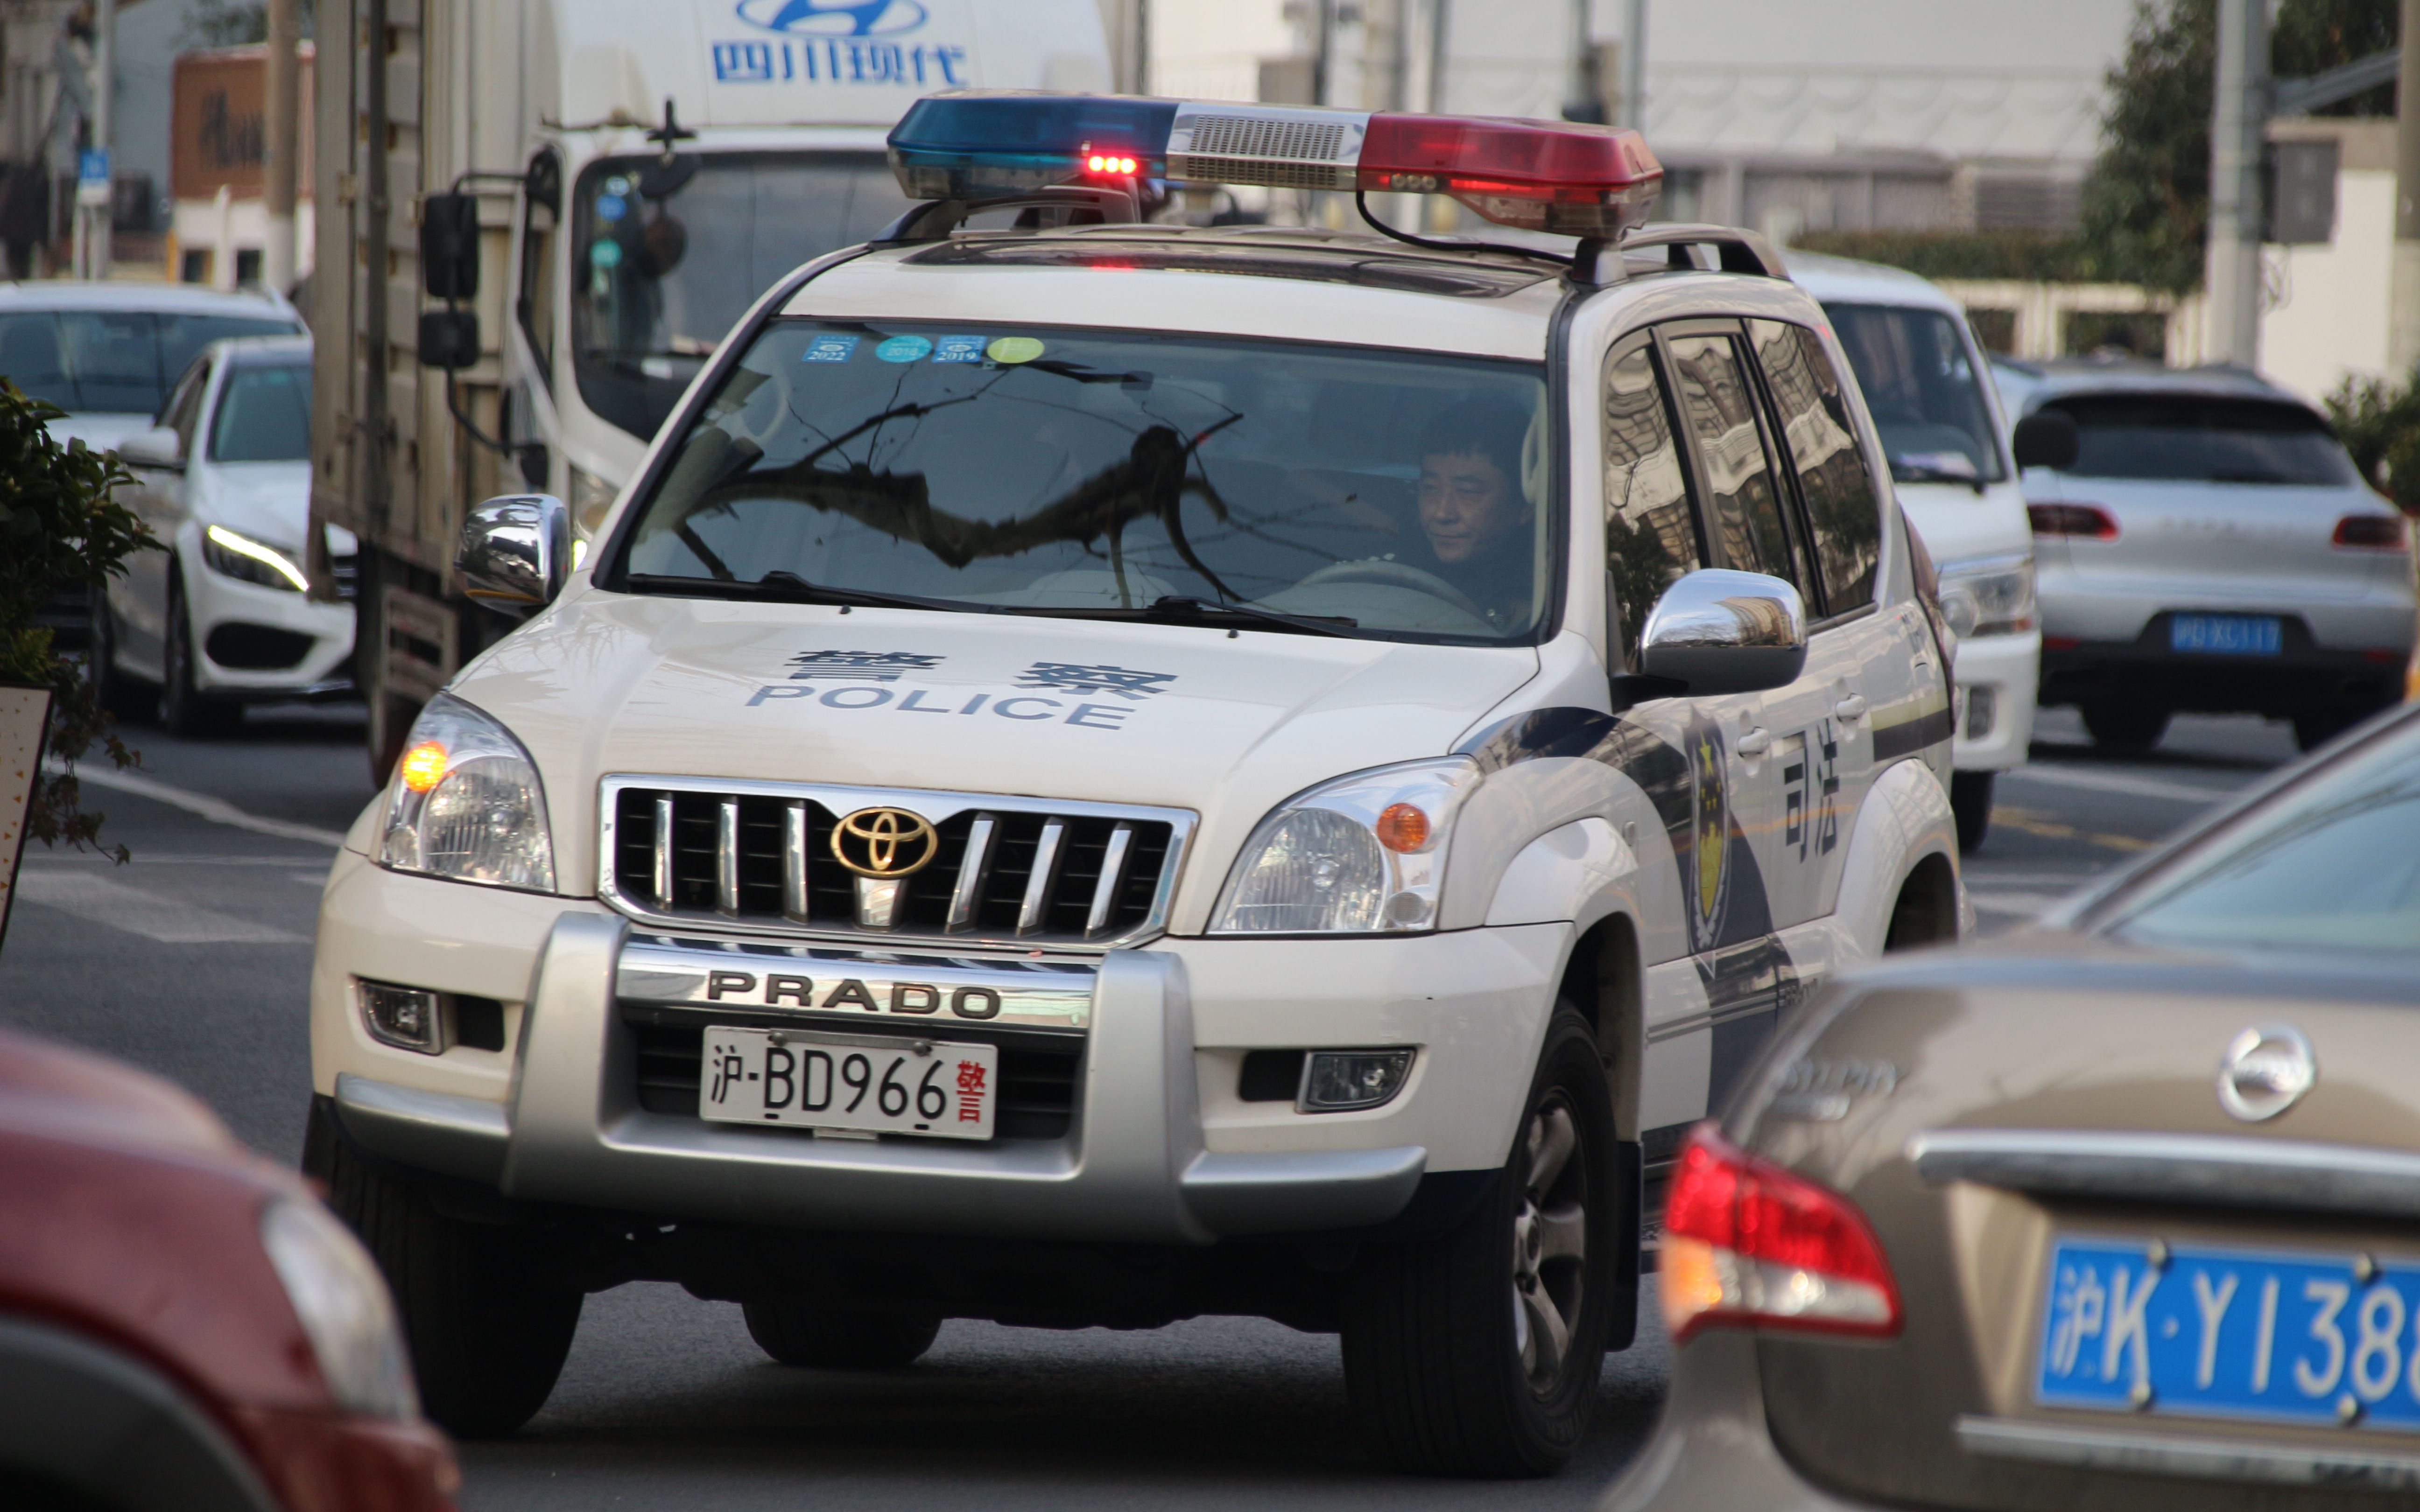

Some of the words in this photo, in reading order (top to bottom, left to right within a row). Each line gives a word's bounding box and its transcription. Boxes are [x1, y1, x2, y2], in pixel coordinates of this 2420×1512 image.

[808, 351, 846, 360] 2022
[937, 351, 977, 360] 2019
[744, 684, 1136, 731] POLICE
[707, 970, 1000, 1020] PRADO
